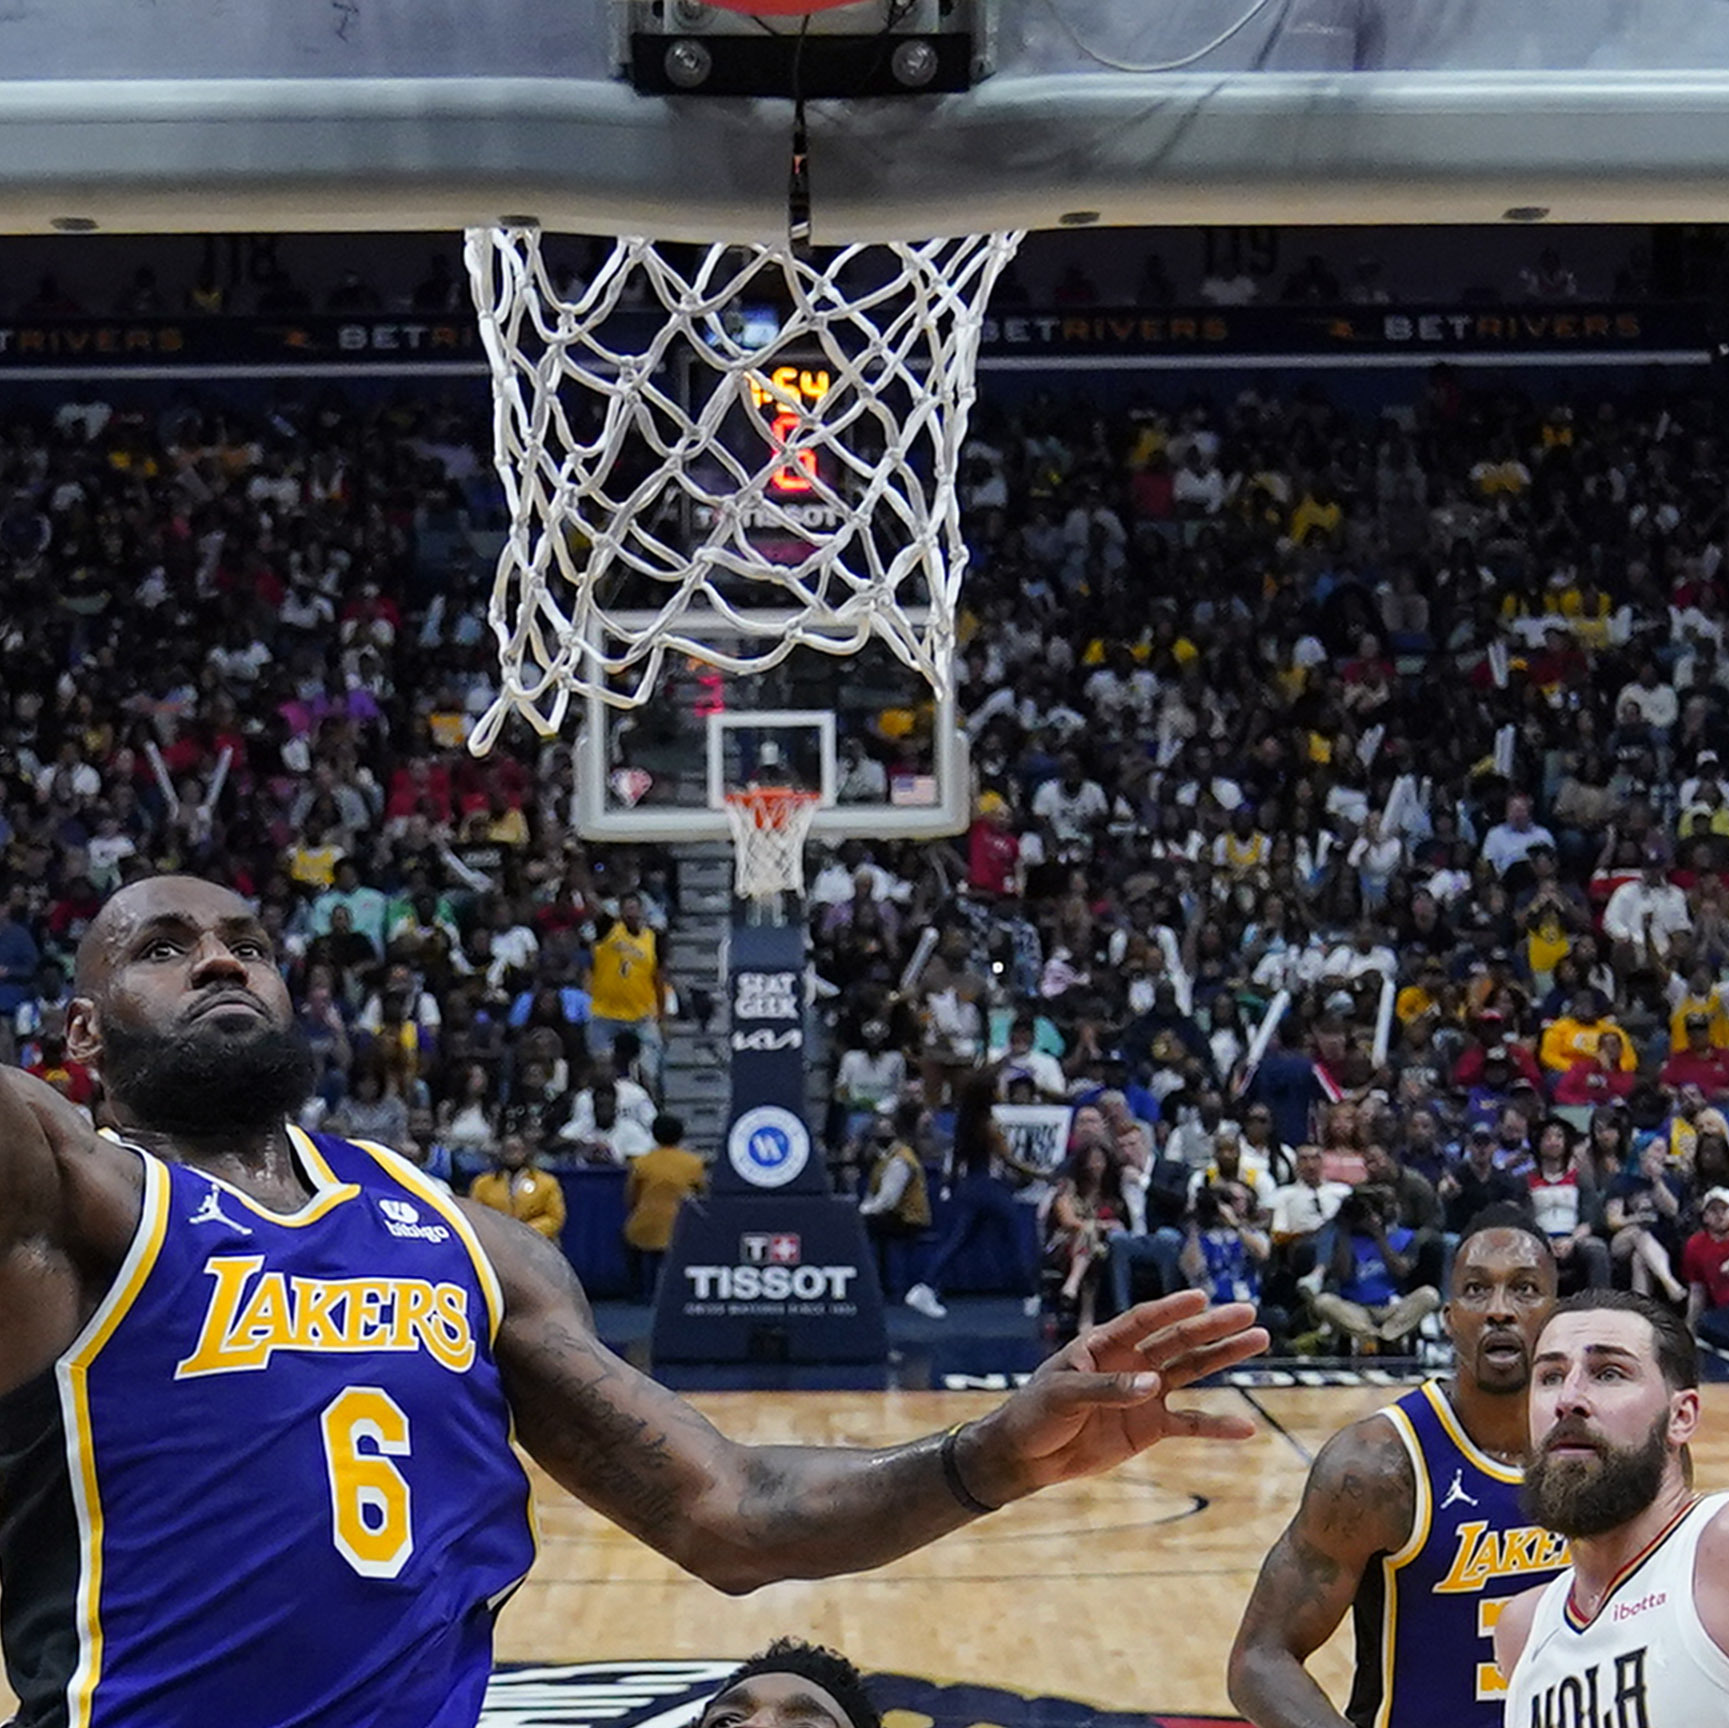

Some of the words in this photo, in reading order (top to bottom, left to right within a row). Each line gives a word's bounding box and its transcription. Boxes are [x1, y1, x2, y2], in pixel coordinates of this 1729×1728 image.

[1383, 312, 1640, 342] BETRIVERS
[384, 1220, 450, 1243] bibigo
[684, 1266, 858, 1300] TISSOT
[174, 1254, 476, 1381] LAKERS
[320, 1386, 415, 1580] 6
[1432, 1519, 1575, 1595] LAKE
[1612, 1590, 1667, 1623] ibotta
